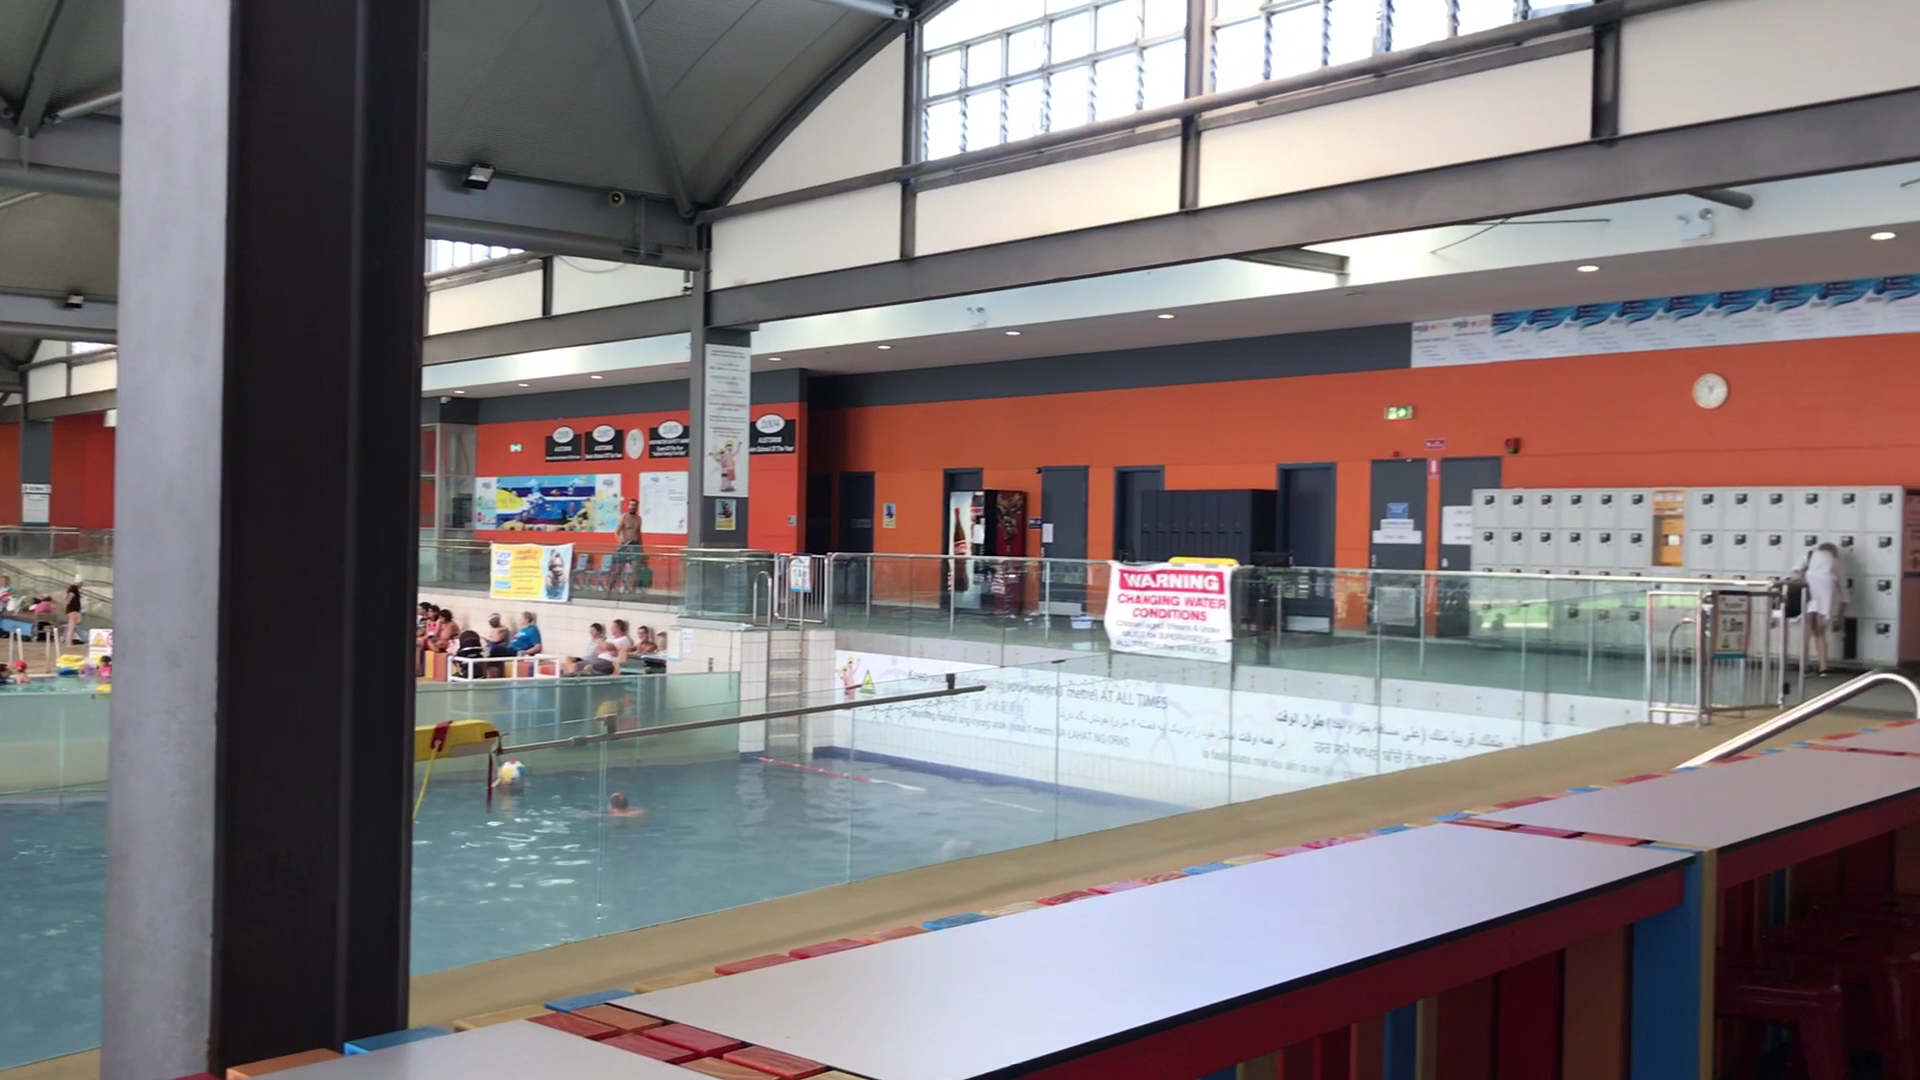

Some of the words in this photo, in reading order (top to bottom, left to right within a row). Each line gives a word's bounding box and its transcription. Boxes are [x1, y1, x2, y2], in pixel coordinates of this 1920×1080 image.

[1122, 573, 1220, 591] WARNING
[1117, 593, 1180, 606] CHANGING
[1184, 597, 1226, 610] WATER
[1132, 607, 1207, 621] CONDITIONS
[1100, 690, 1115, 702] AT
[1116, 691, 1135, 706] ALL
[1137, 693, 1168, 710] TIMES
